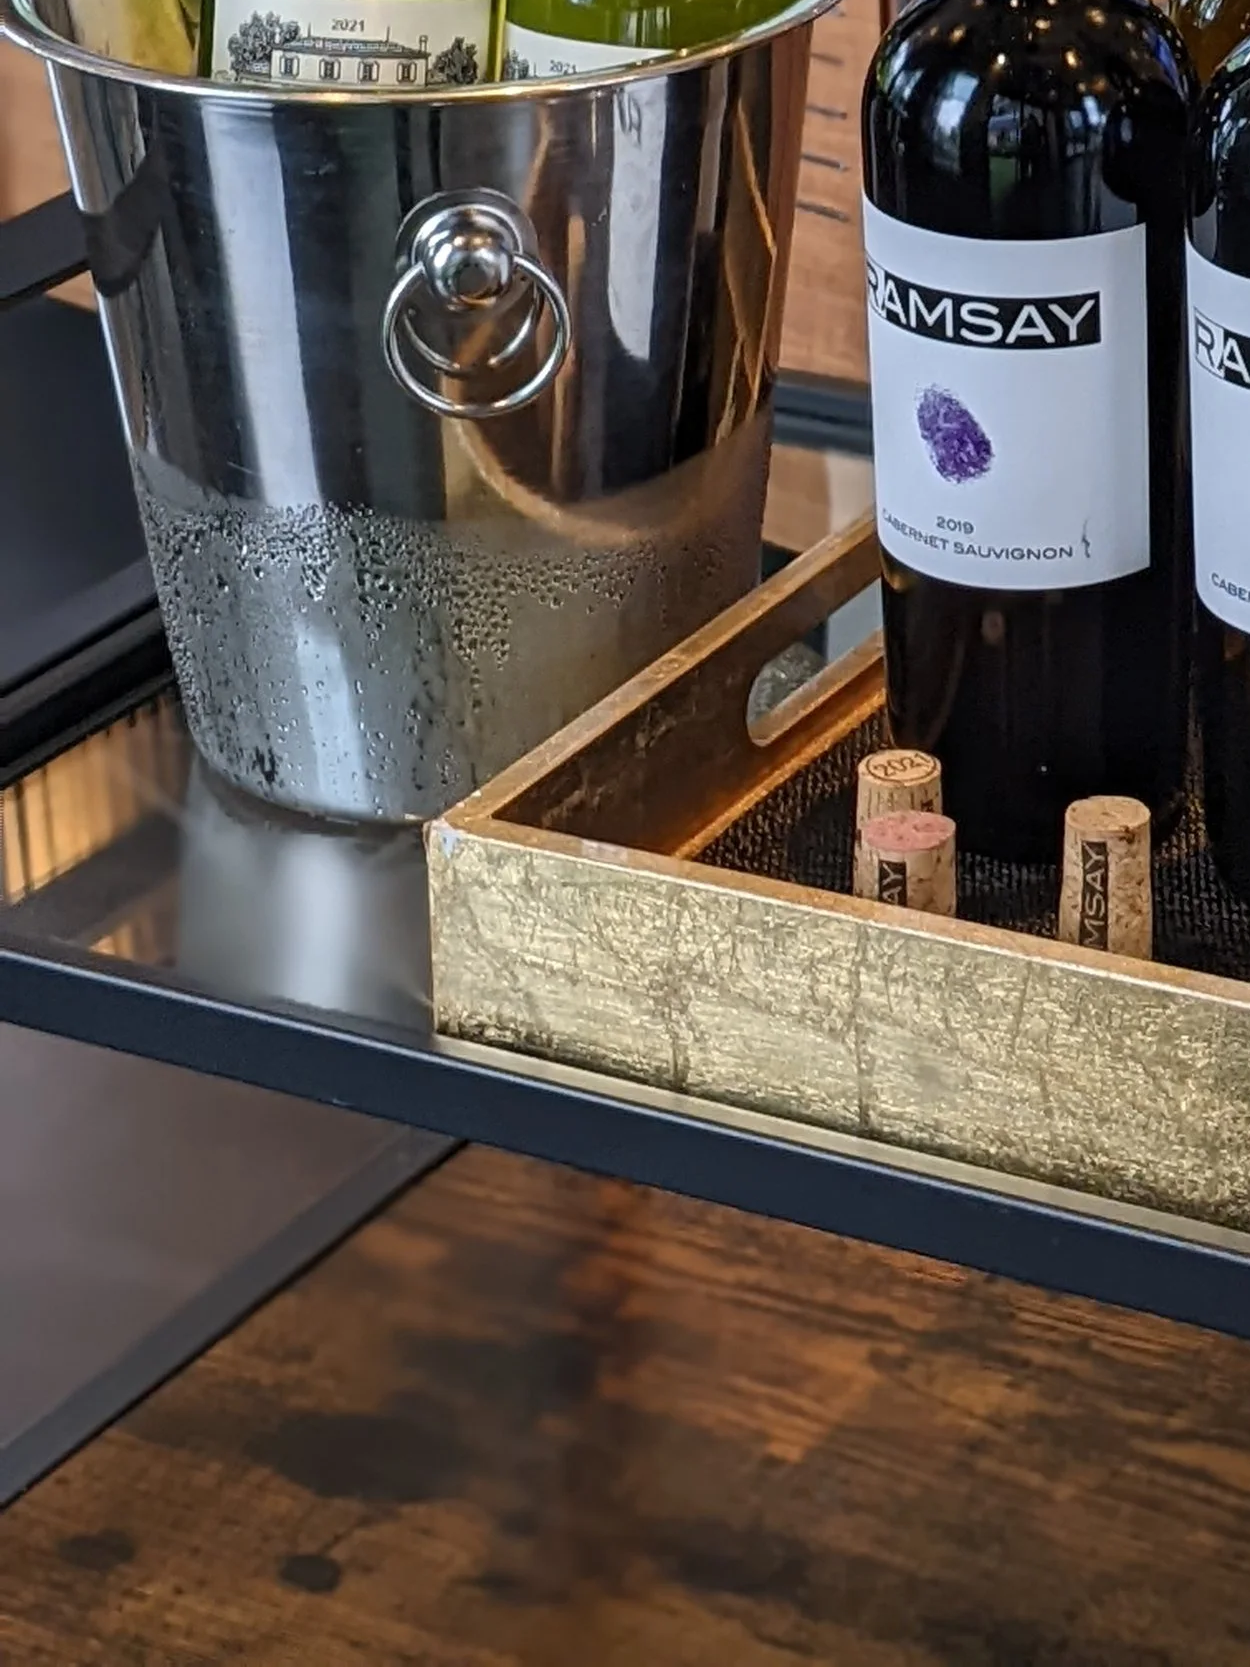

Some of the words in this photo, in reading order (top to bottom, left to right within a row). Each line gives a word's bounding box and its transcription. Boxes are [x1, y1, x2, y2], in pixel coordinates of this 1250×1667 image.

[331, 18, 365, 32] 2021
[549, 59, 577, 75] 2021
[936, 515, 974, 534] 2019
[882, 508, 950, 551] CABERNET
[953, 541, 1073, 561] SAUVIGNON
[873, 752, 931, 777] 2021
